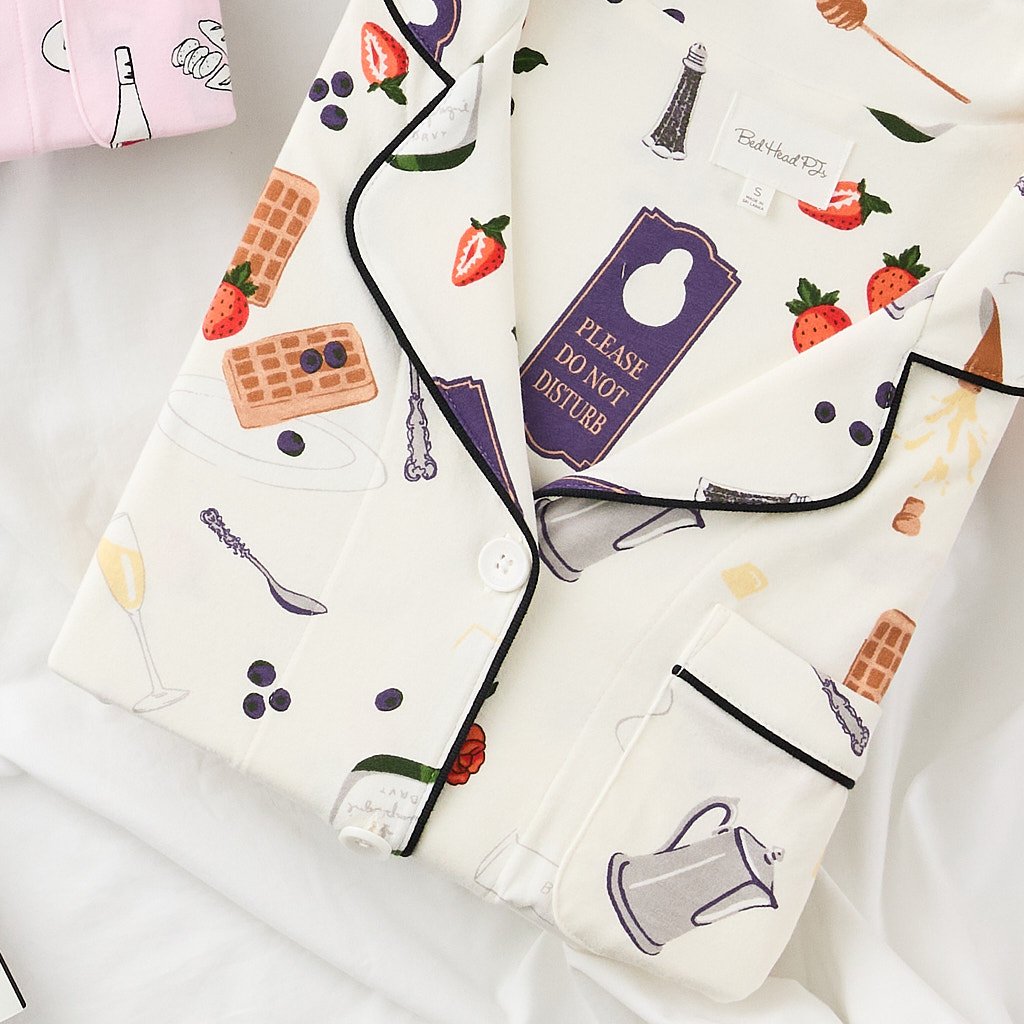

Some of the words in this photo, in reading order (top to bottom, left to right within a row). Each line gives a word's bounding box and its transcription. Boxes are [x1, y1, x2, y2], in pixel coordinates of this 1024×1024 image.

[735, 128, 764, 152] Bed
[765, 140, 800, 168] Head
[801, 156, 828, 178] PJs
[753, 186, 763, 197] S
[554, 342, 587, 374] DO
[583, 365, 630, 407] NOT
[575, 316, 650, 380] PLEASE
[532, 368, 608, 436] DISTURB
